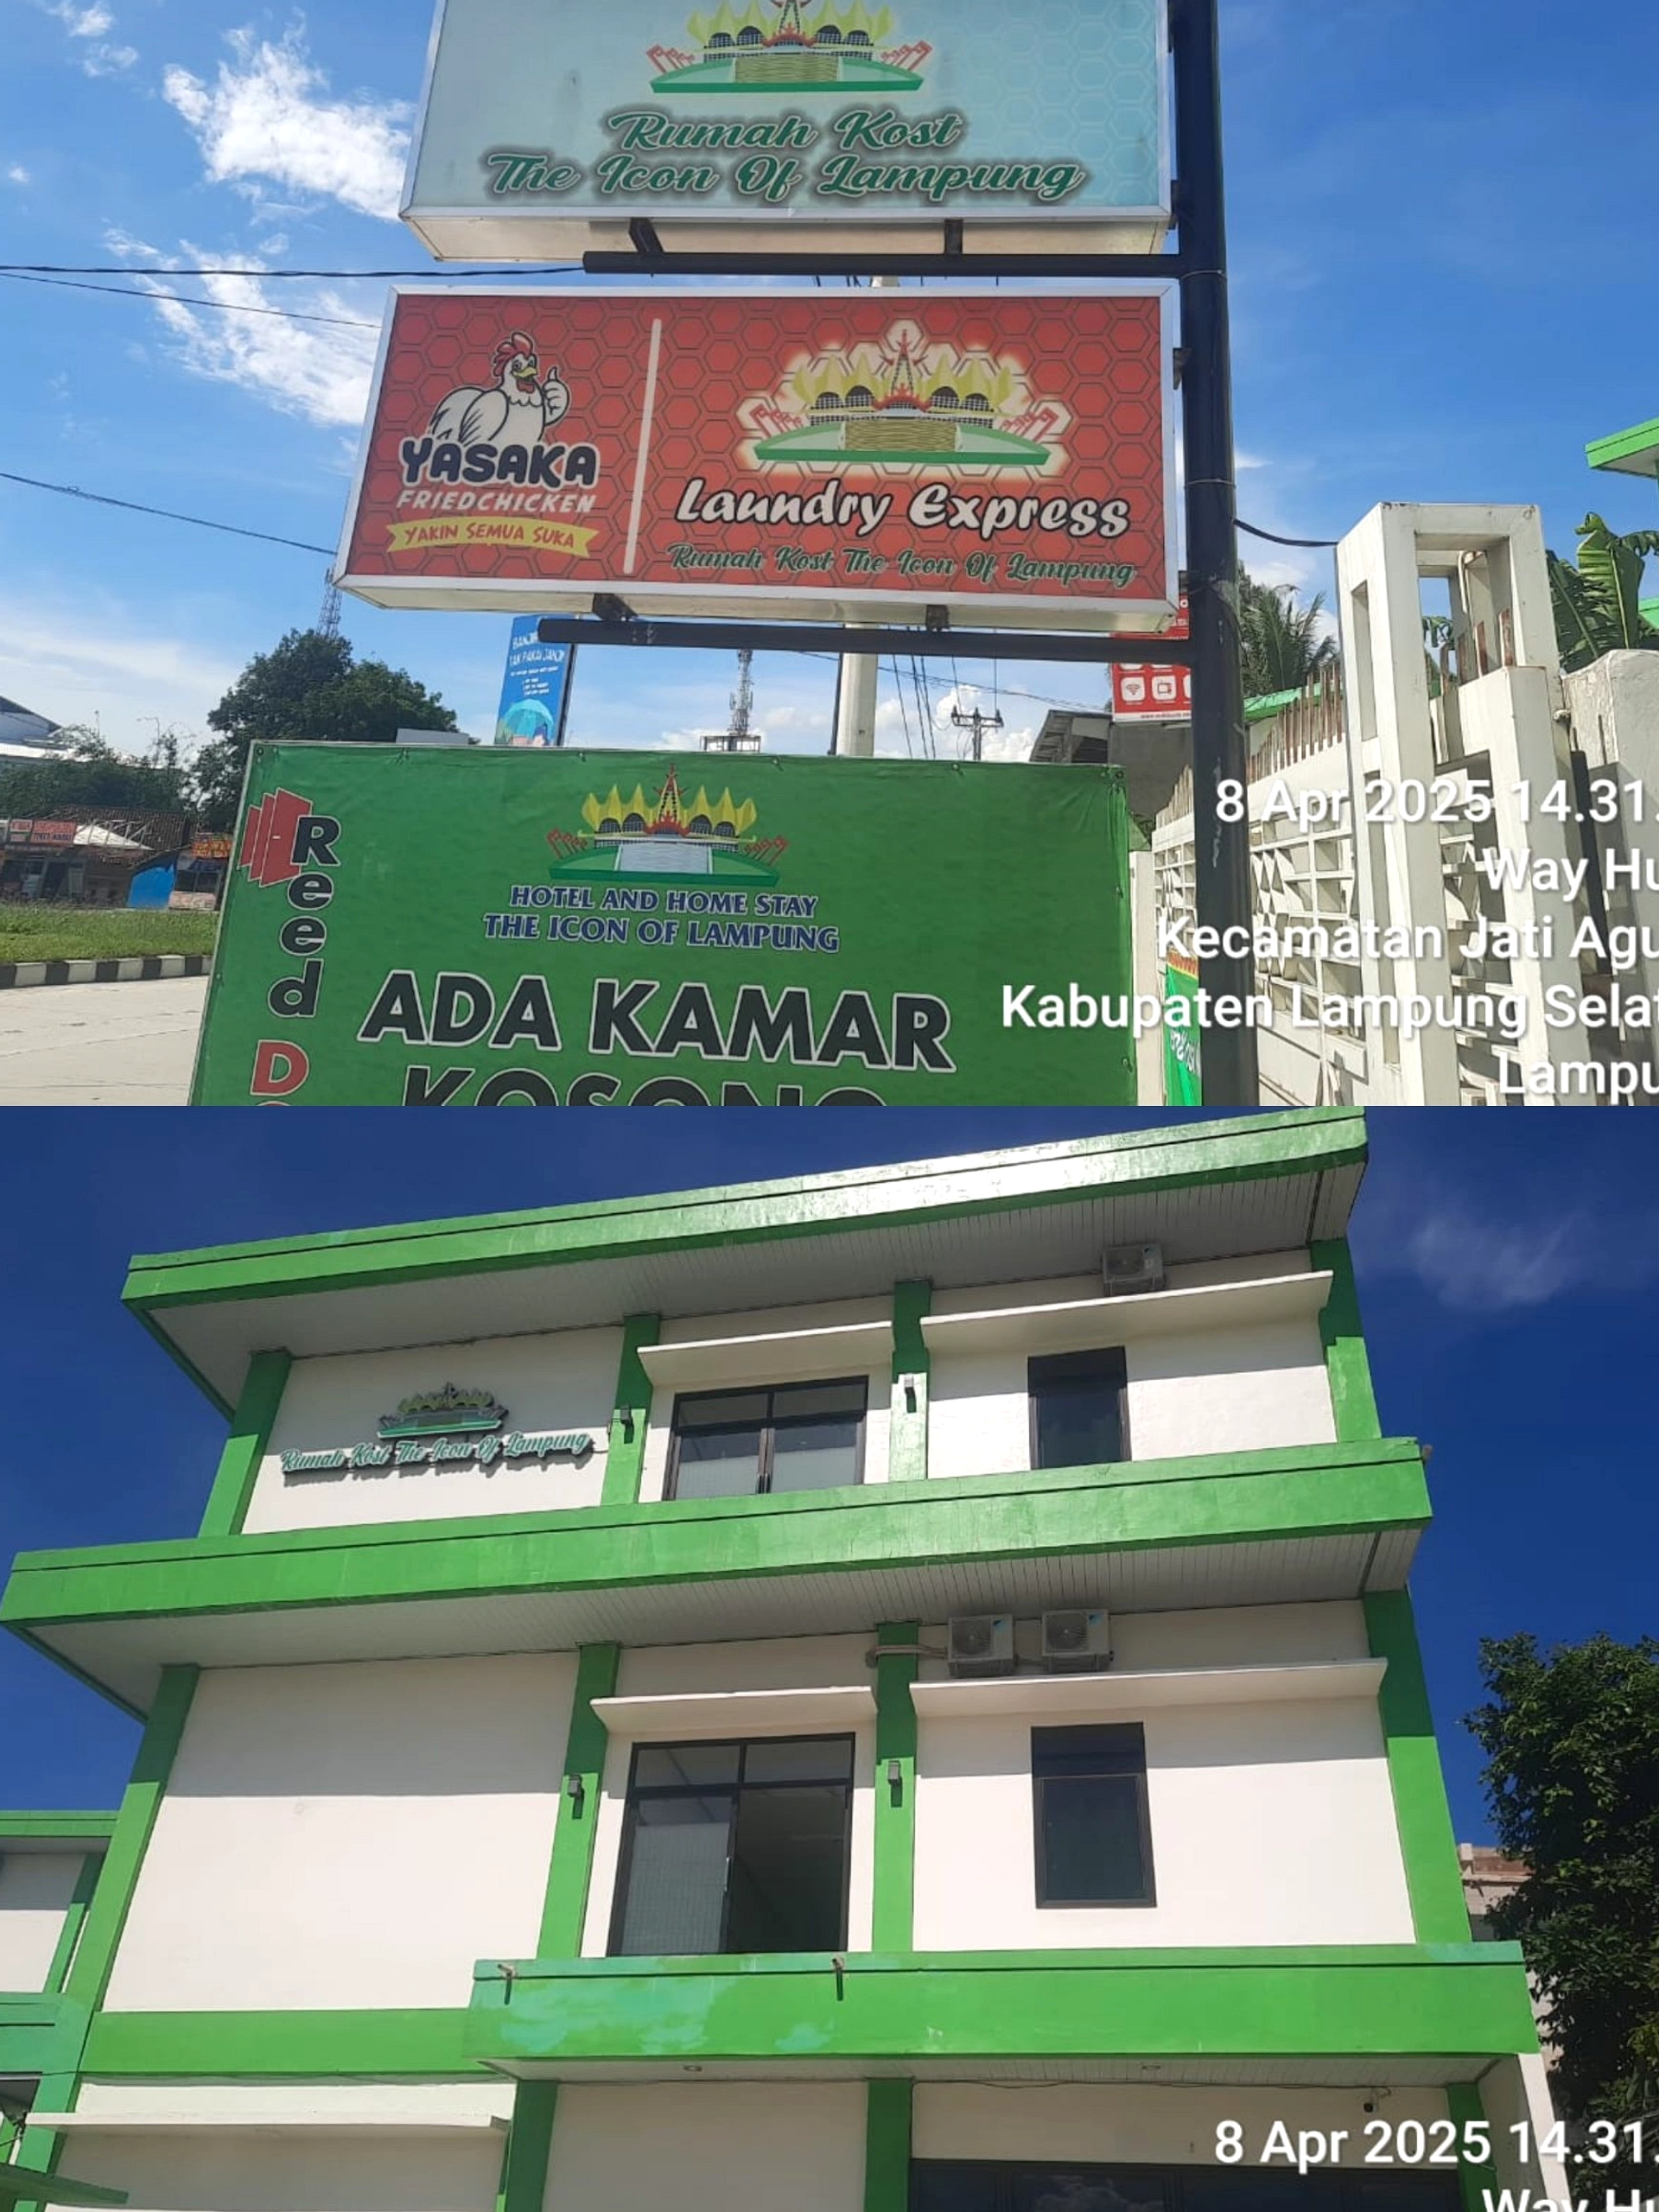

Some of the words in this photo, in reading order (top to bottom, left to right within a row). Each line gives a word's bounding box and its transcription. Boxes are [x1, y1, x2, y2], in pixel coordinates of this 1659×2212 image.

[610, 111, 815, 149] Rumah
[833, 109, 961, 149] Kost
[488, 153, 578, 193] The
[600, 152, 716, 193] Icon
[736, 153, 800, 202] Of
[817, 153, 1083, 202] Lampung
[400, 436, 600, 492] YASAKA
[397, 490, 596, 513] FRIEDCHICKEN
[676, 479, 893, 537] Laundry
[908, 482, 1131, 542] Express
[405, 524, 458, 544] YAKIN
[466, 523, 524, 540] SEMUA
[533, 526, 575, 548] SUKA
[667, 543, 763, 571] Rumah
[774, 545, 834, 572] Kost
[842, 548, 887, 575] The
[897, 550, 956, 576] Icon
[966, 550, 996, 583] Of
[1007, 553, 1137, 587] Lampung
[268, 815, 341, 1018] Reed
[509, 886, 594, 909] HOTEL
[600, 888, 658, 912] AND
[667, 891, 748, 915] HOME
[754, 894, 818, 918] STAY
[484, 914, 540, 939] THE
[547, 914, 629, 944] ICON
[637, 918, 679, 945] OF
[686, 922, 840, 953] LAMPUNG
[357, 969, 563, 1051] ADA
[588, 977, 957, 1072] KAMAR
[251, 1039, 309, 1106] D
[280, 1448, 346, 1473] Rumah
[349, 1442, 391, 1467] Kost
[395, 1440, 424, 1465] The
[431, 1437, 473, 1460] Icon
[475, 1434, 501, 1465] Of
[505, 1432, 592, 1459] Lampung
